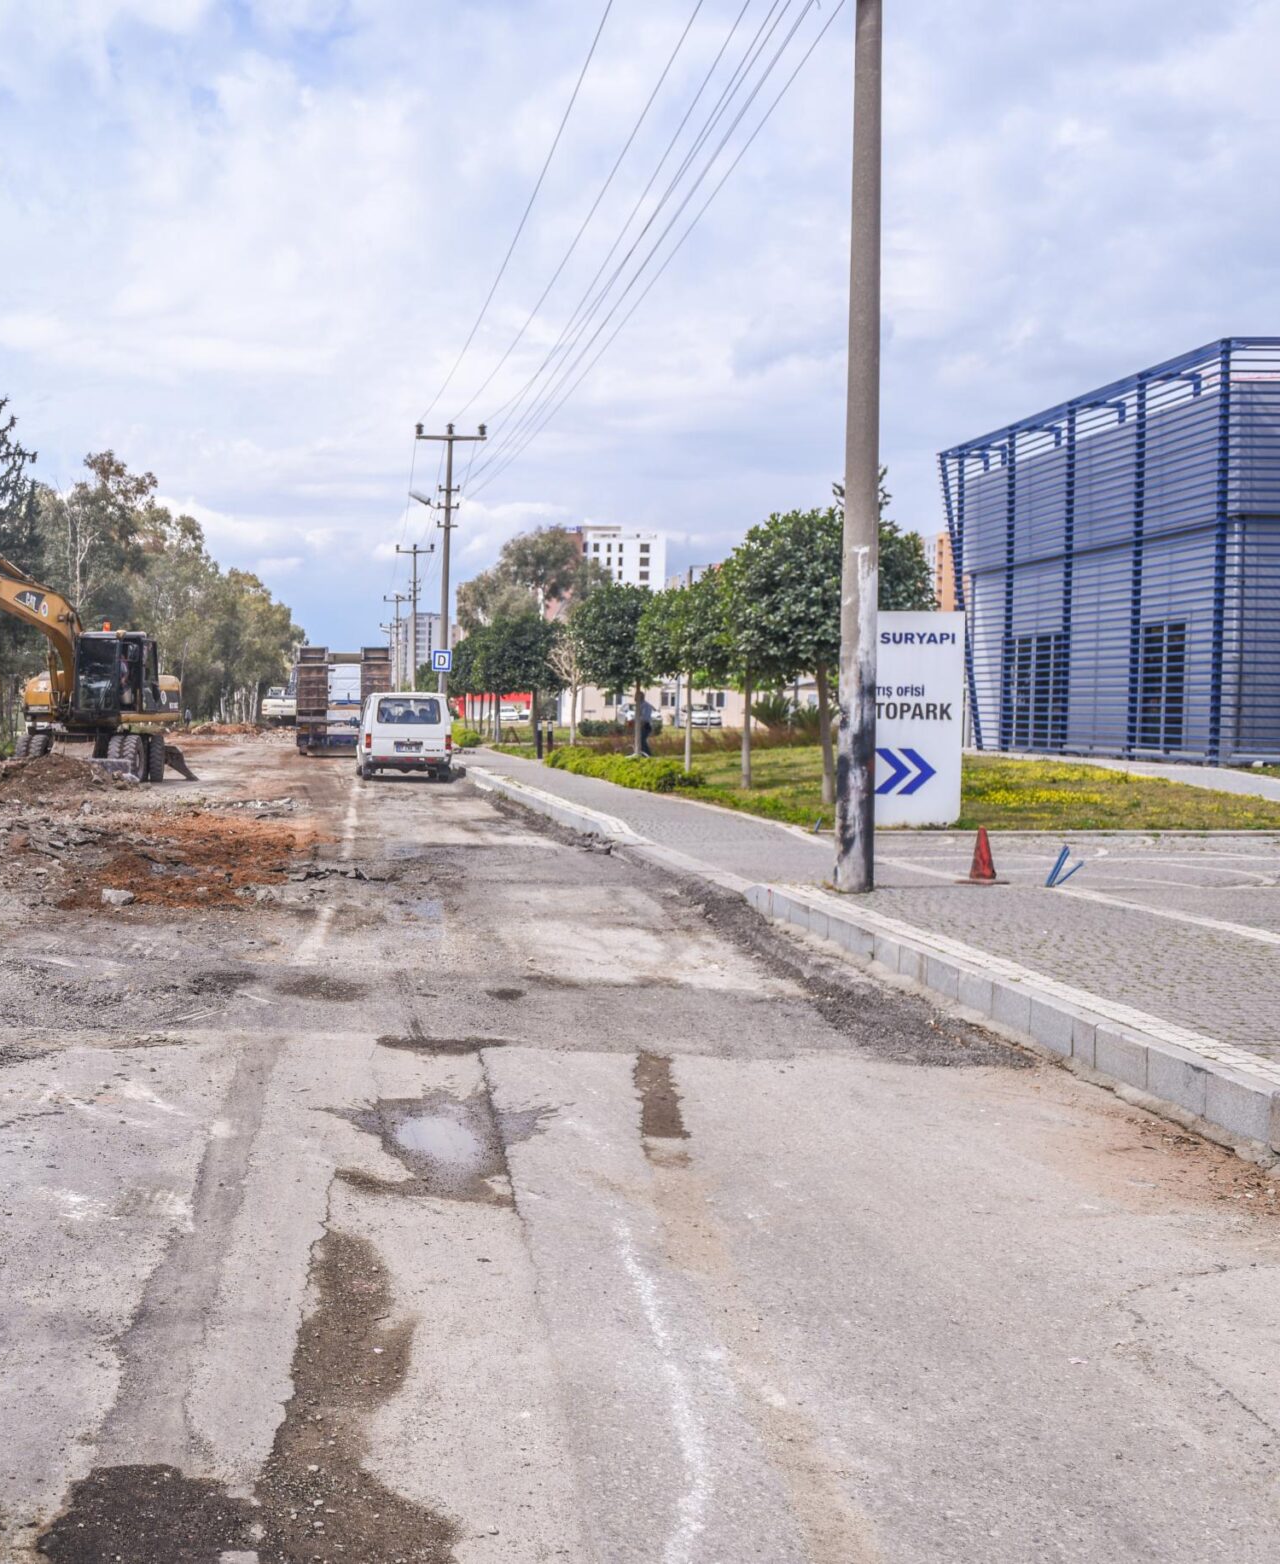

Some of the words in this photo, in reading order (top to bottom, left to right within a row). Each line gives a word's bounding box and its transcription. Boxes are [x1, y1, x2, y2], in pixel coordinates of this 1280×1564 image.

[880, 632, 956, 645] SURYAPI
[437, 654, 447, 666] D
[896, 684, 925, 697] OFİSİ
